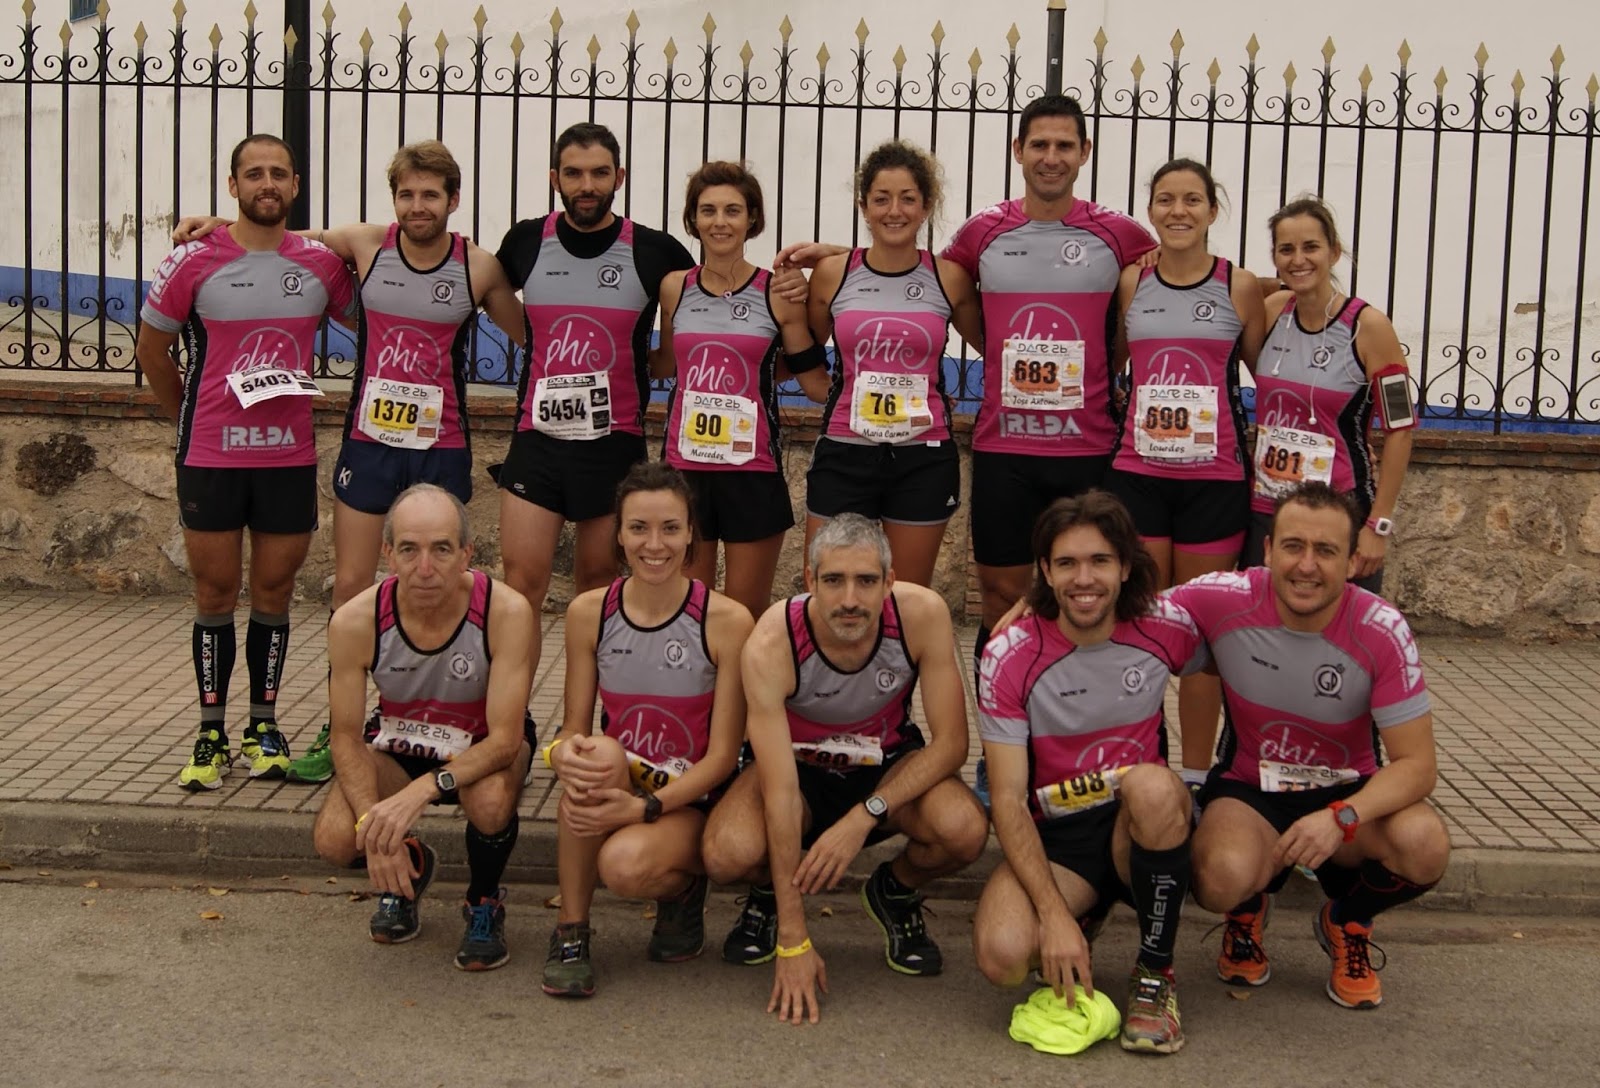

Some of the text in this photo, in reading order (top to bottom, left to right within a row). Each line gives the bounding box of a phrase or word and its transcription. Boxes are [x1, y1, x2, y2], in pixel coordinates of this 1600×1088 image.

[375, 331, 424, 378] phi
[544, 320, 594, 378] phi
[855, 321, 909, 378] phi
[686, 347, 730, 391] phi
[1014, 359, 1057, 384] 683
[240, 374, 292, 393] 5403
[373, 398, 419, 424] 1378
[539, 398, 587, 422] 5454
[870, 392, 896, 416] 76
[695, 412, 722, 437] 90
[1146, 406, 1188, 431] 690
[690, 448, 724, 460] Mercedes
[1264, 445, 1301, 475] 681
[639, 761, 669, 789] 79
